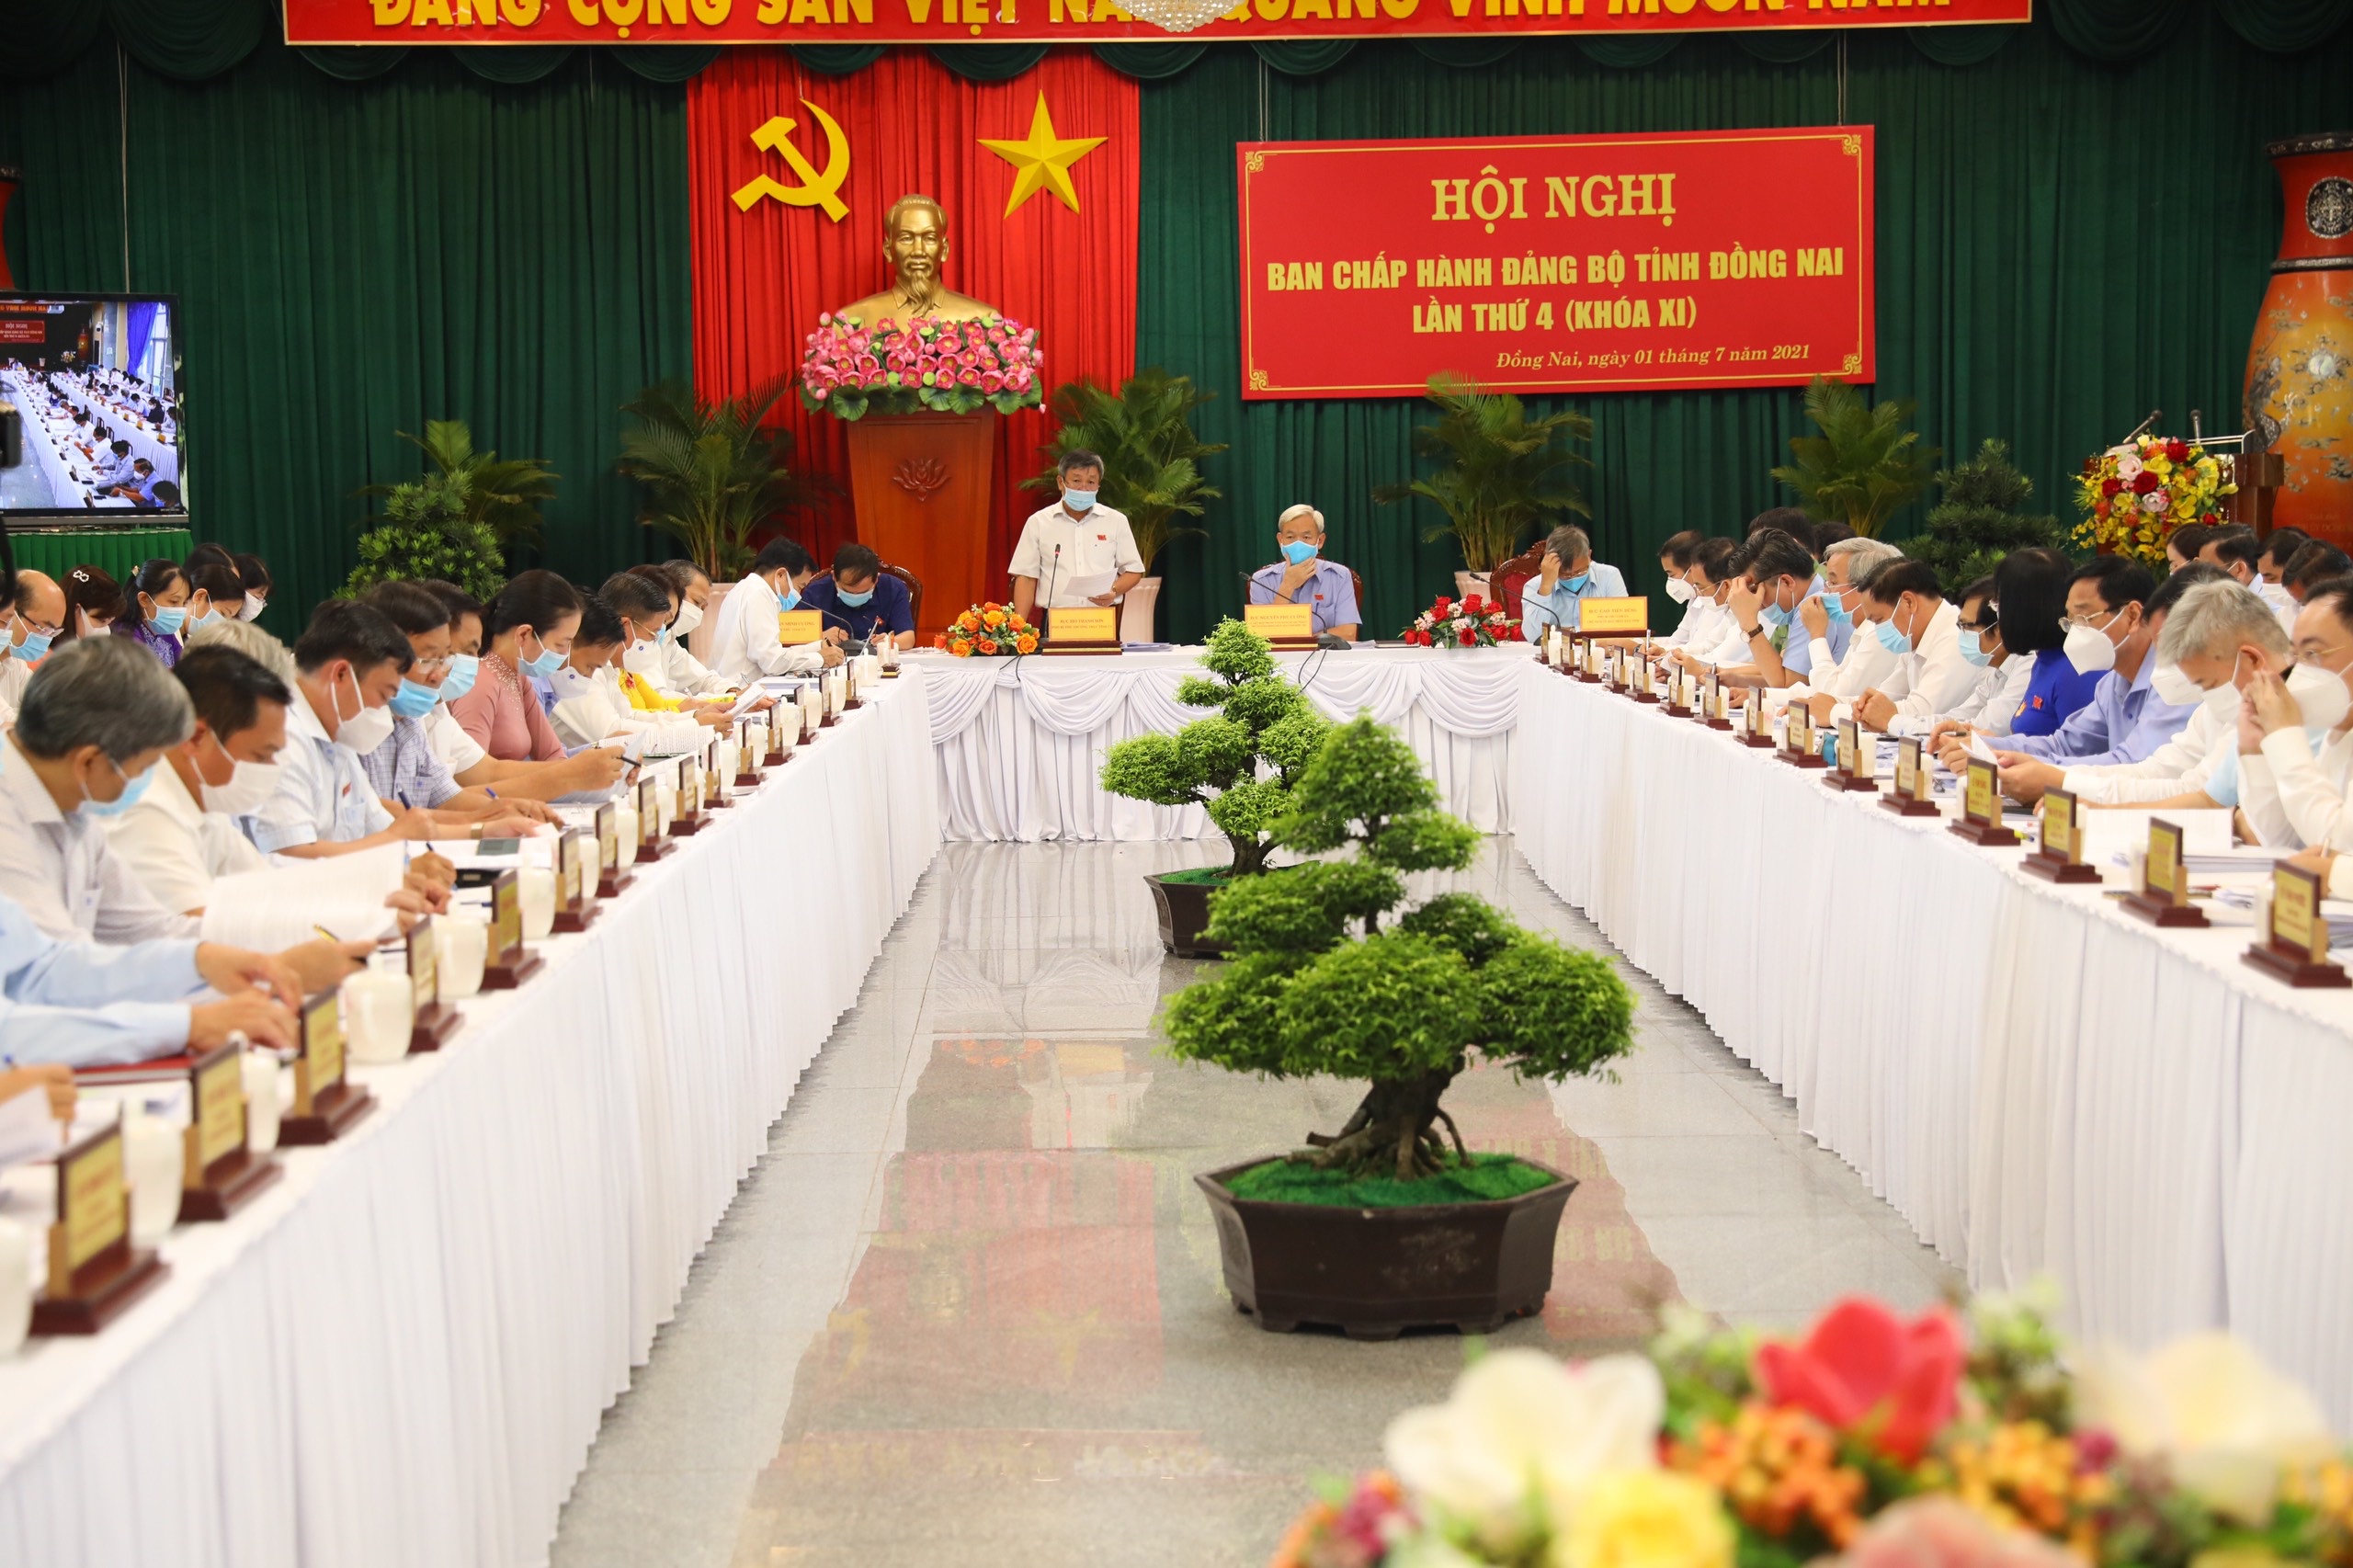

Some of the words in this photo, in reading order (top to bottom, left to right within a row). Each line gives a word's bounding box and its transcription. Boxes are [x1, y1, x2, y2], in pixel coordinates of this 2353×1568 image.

[1431, 164, 1528, 233] HỘI
[1545, 173, 1676, 227] NGHỊ
[1267, 261, 1323, 291] BAN
[1333, 250, 1407, 290] CHẤP
[1417, 254, 1492, 288] HÀNH
[1500, 249, 1577, 285] ĐẢNG
[1587, 249, 1625, 289] BỘ
[1634, 246, 1699, 282] TỈNH
[1709, 242, 1787, 280] ĐỒNG
[1797, 247, 1844, 277] NAI
[1413, 296, 1462, 334] LẦN
[1472, 298, 1530, 332] THỨ
[1535, 301, 1554, 330] 4
[1565, 296, 1650, 332] (KHÓA
[1659, 297, 1698, 328] XI)
[1496, 349, 1544, 369] Đồng
[1548, 350, 1583, 368] Nai,
[1587, 350, 1631, 368] ngày
[1634, 349, 1654, 364] 01
[1658, 347, 1711, 366] tháng
[1714, 347, 1726, 361] 7
[1729, 345, 1768, 361] năm
[1771, 344, 1811, 359] 2021
